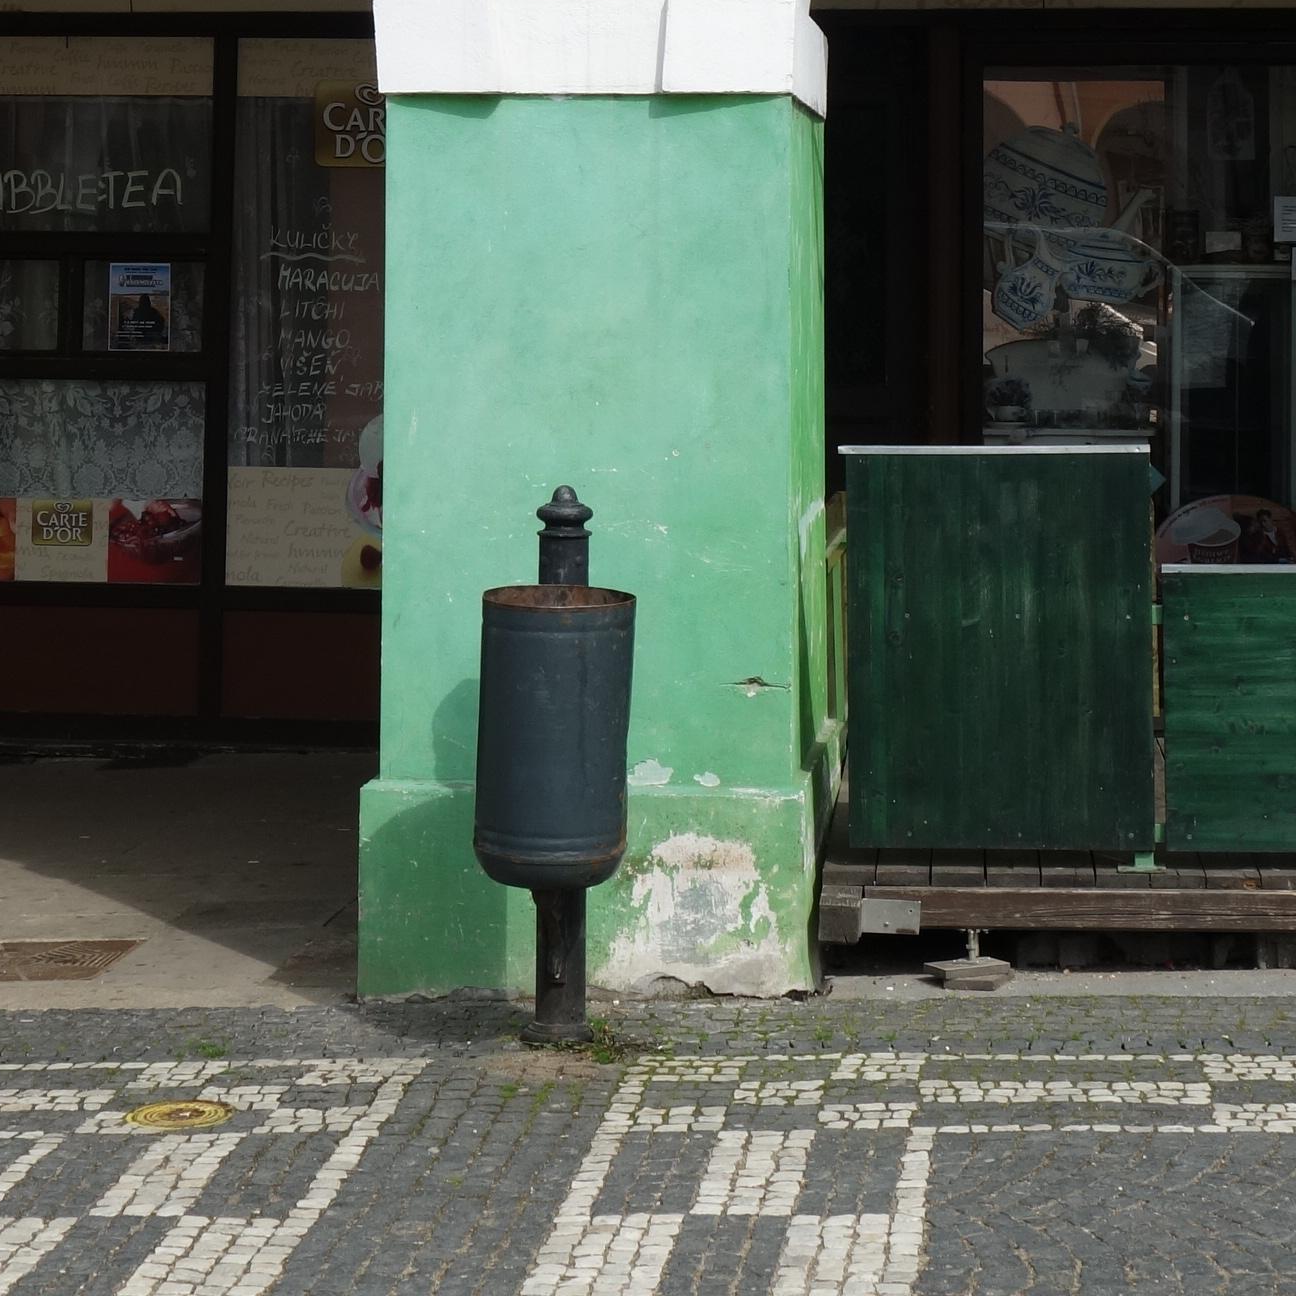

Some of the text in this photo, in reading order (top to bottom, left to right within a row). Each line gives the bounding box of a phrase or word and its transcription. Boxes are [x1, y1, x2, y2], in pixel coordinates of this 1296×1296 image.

[100, 167, 185, 210] TEA
[269, 223, 360, 251] KULIČKY
[277, 328, 351, 352] MANGO
[36, 510, 89, 529] CARTE
